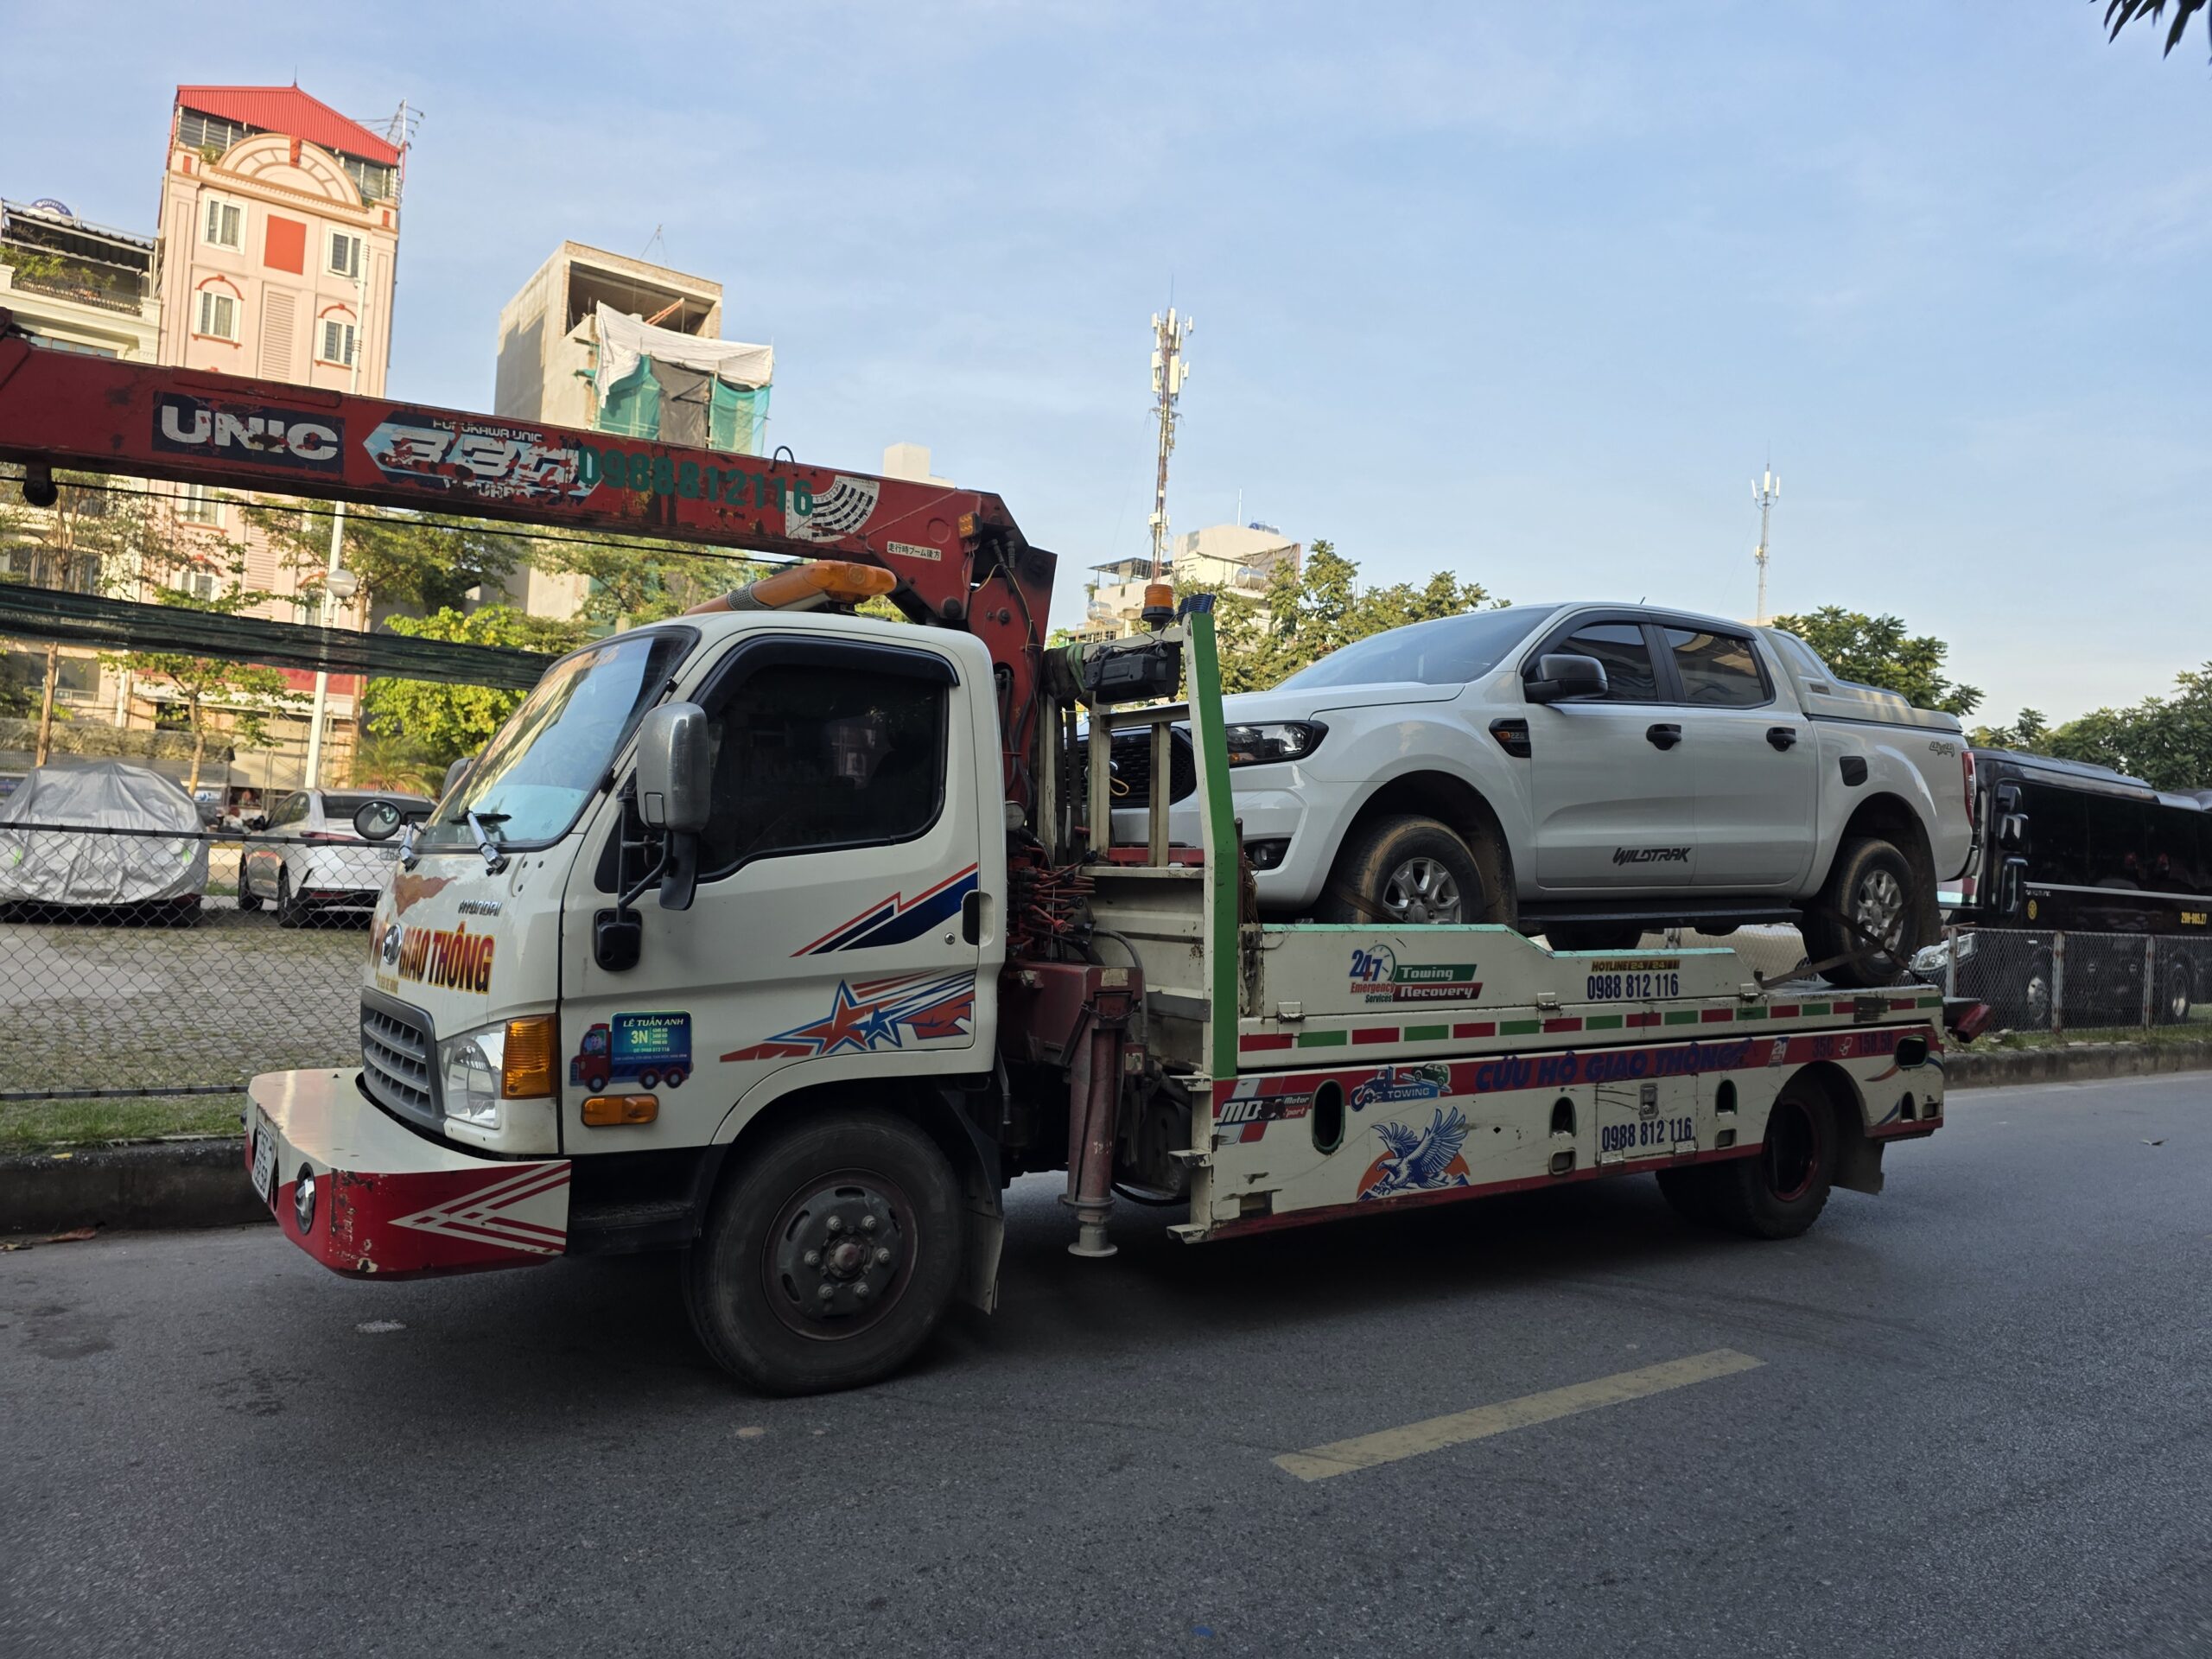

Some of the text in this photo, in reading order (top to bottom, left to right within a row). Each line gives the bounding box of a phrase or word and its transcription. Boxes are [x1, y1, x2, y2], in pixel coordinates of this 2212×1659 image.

[162, 404, 338, 461] UNIC
[512, 429, 543, 442] UNIC
[578, 445, 813, 517] 0988812116
[888, 543, 941, 560] 走行時ブーム後方
[1612, 847, 1692, 867] WILDTRAK
[458, 899, 504, 918] HYUNDAI
[397, 926, 432, 986] GIAO
[428, 920, 496, 995] THÔNG
[1592, 960, 1629, 972] HOTLINE
[1401, 967, 1454, 981] Towing
[1351, 982, 1397, 995] Emergency
[1400, 986, 1474, 999] Recovery
[1586, 973, 1679, 1001] 0988 812 116
[1365, 994, 1393, 1003] Services
[623, 1019, 634, 1027] LÊ
[631, 1030, 649, 1045] 3N
[1584, 1047, 1649, 1080] GIAO
[1284, 1096, 1309, 1104] Motor
[1387, 1088, 1430, 1099] TOWING
[1285, 1107, 1306, 1117] port
[1602, 1117, 1693, 1151] 0988 812 116
